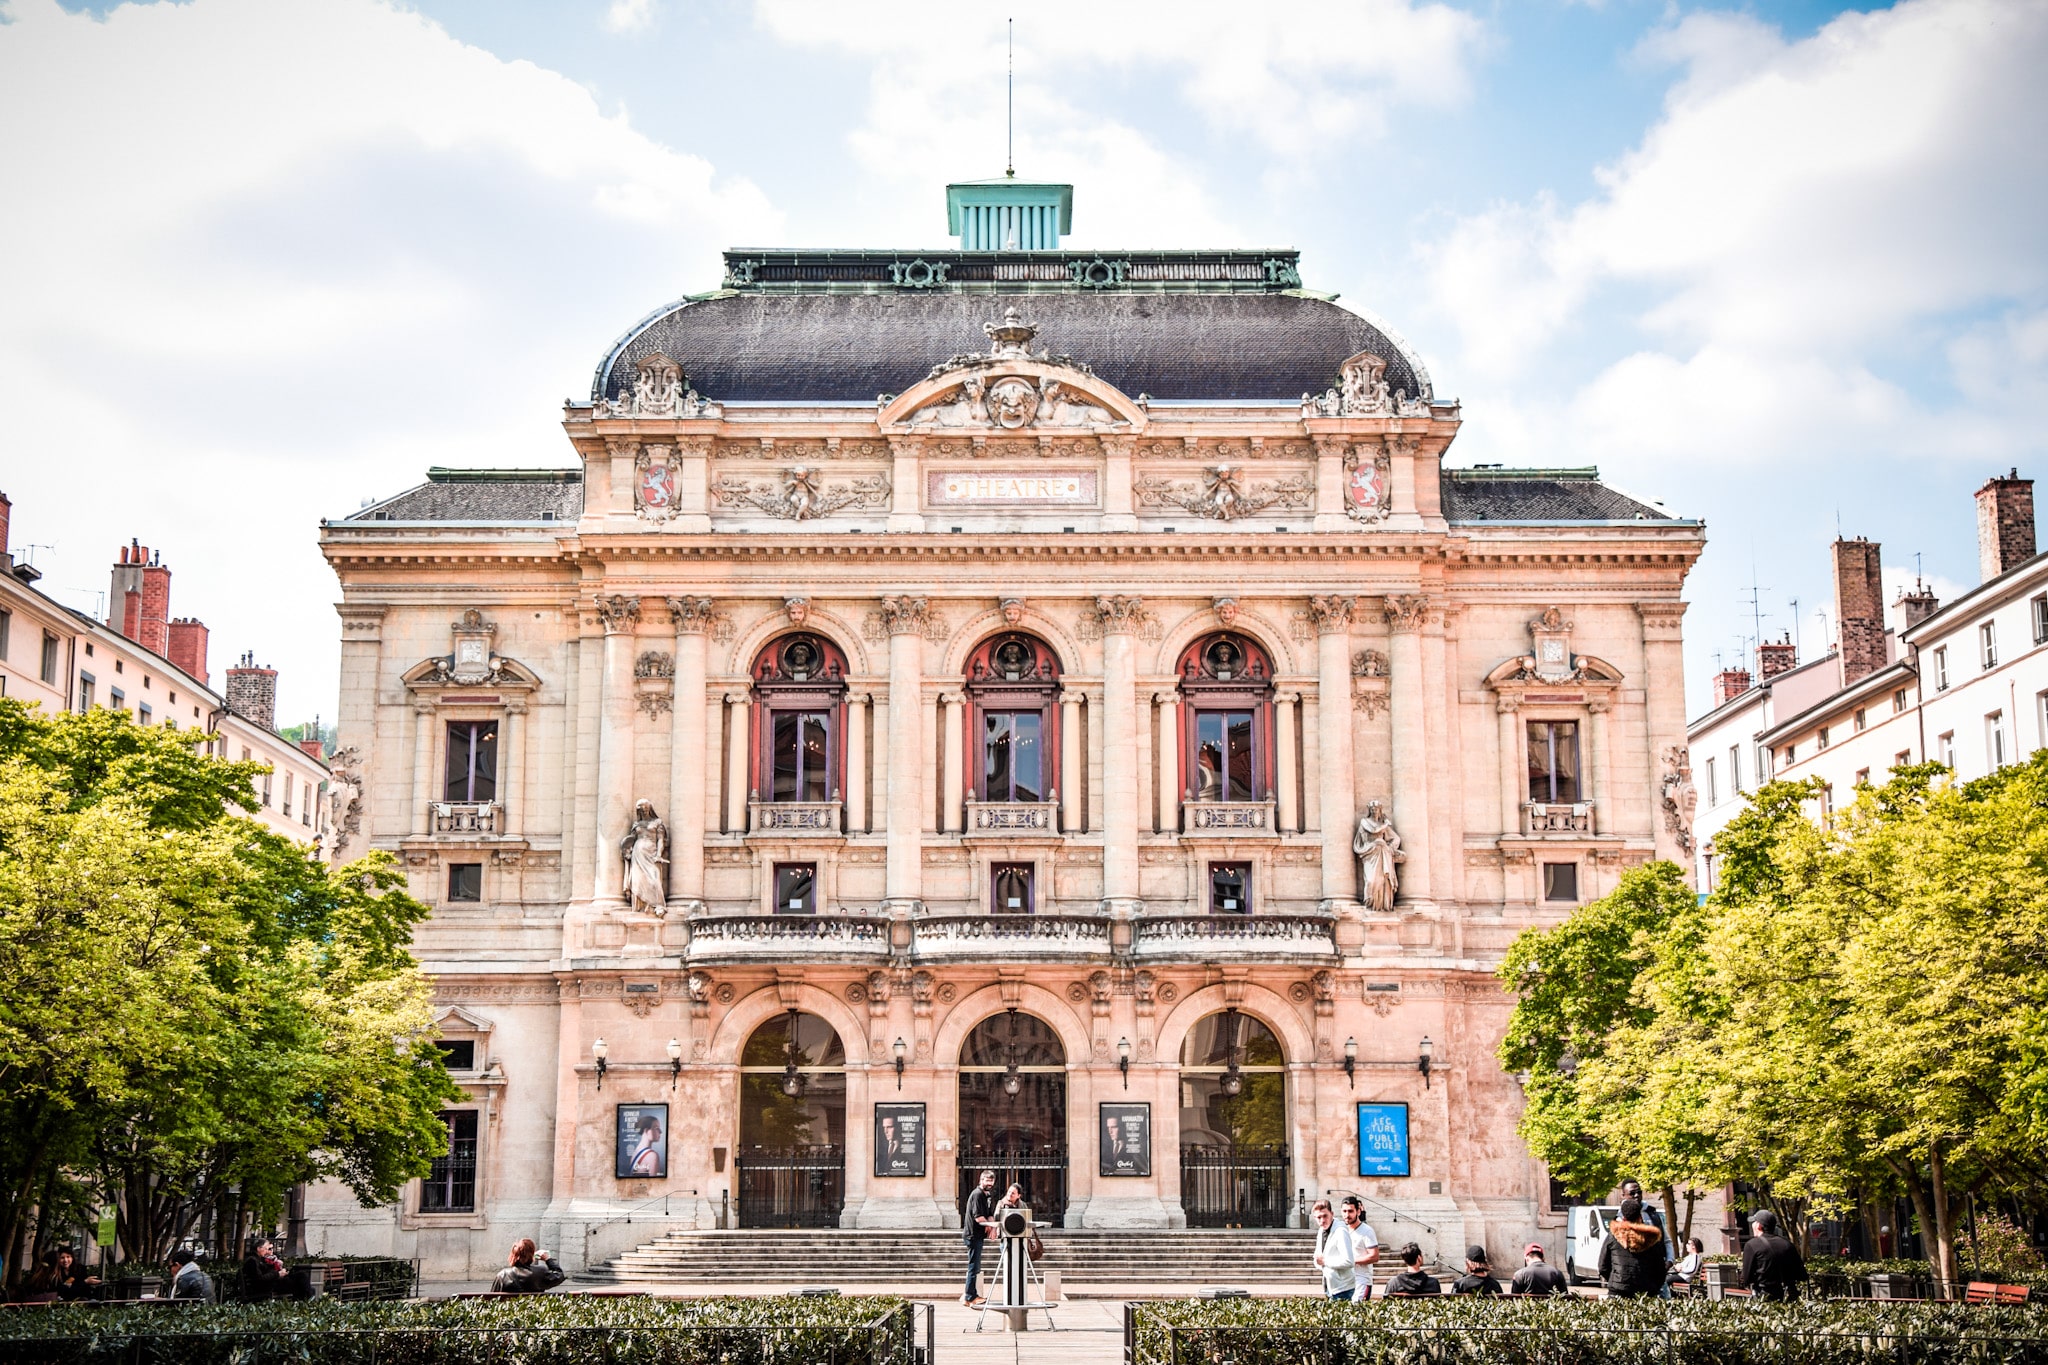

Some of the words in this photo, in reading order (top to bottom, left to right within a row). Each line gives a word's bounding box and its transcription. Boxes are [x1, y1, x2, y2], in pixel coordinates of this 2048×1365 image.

[961, 479, 1064, 497] THEATRE
[1371, 1125, 1396, 1133] TURE
[1369, 1134, 1398, 1142] PUBLI
[1374, 1142, 1393, 1150] QUE
